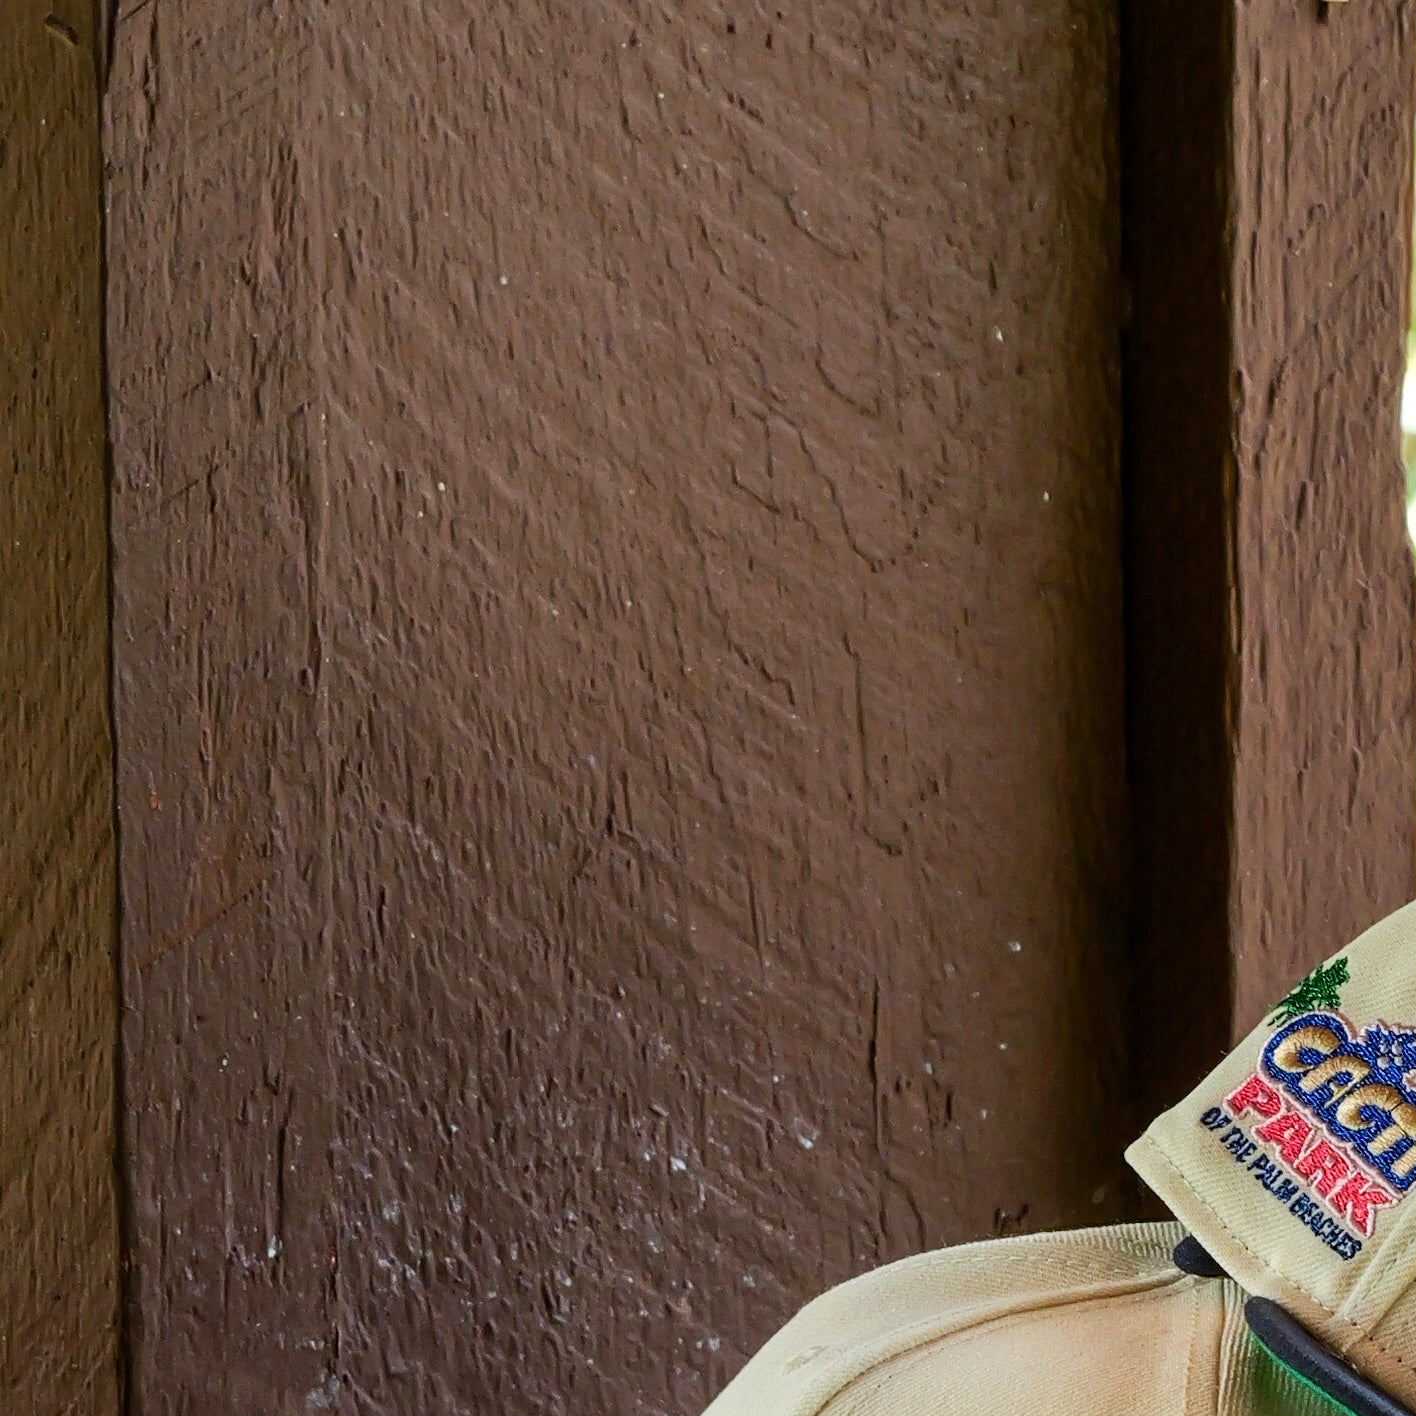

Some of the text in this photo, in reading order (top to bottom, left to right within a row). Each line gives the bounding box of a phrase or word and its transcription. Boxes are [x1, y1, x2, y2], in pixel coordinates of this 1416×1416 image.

[1200, 1107, 1363, 1261] OF THE PALM BEACHES
[1227, 1075, 1394, 1236] PARK
